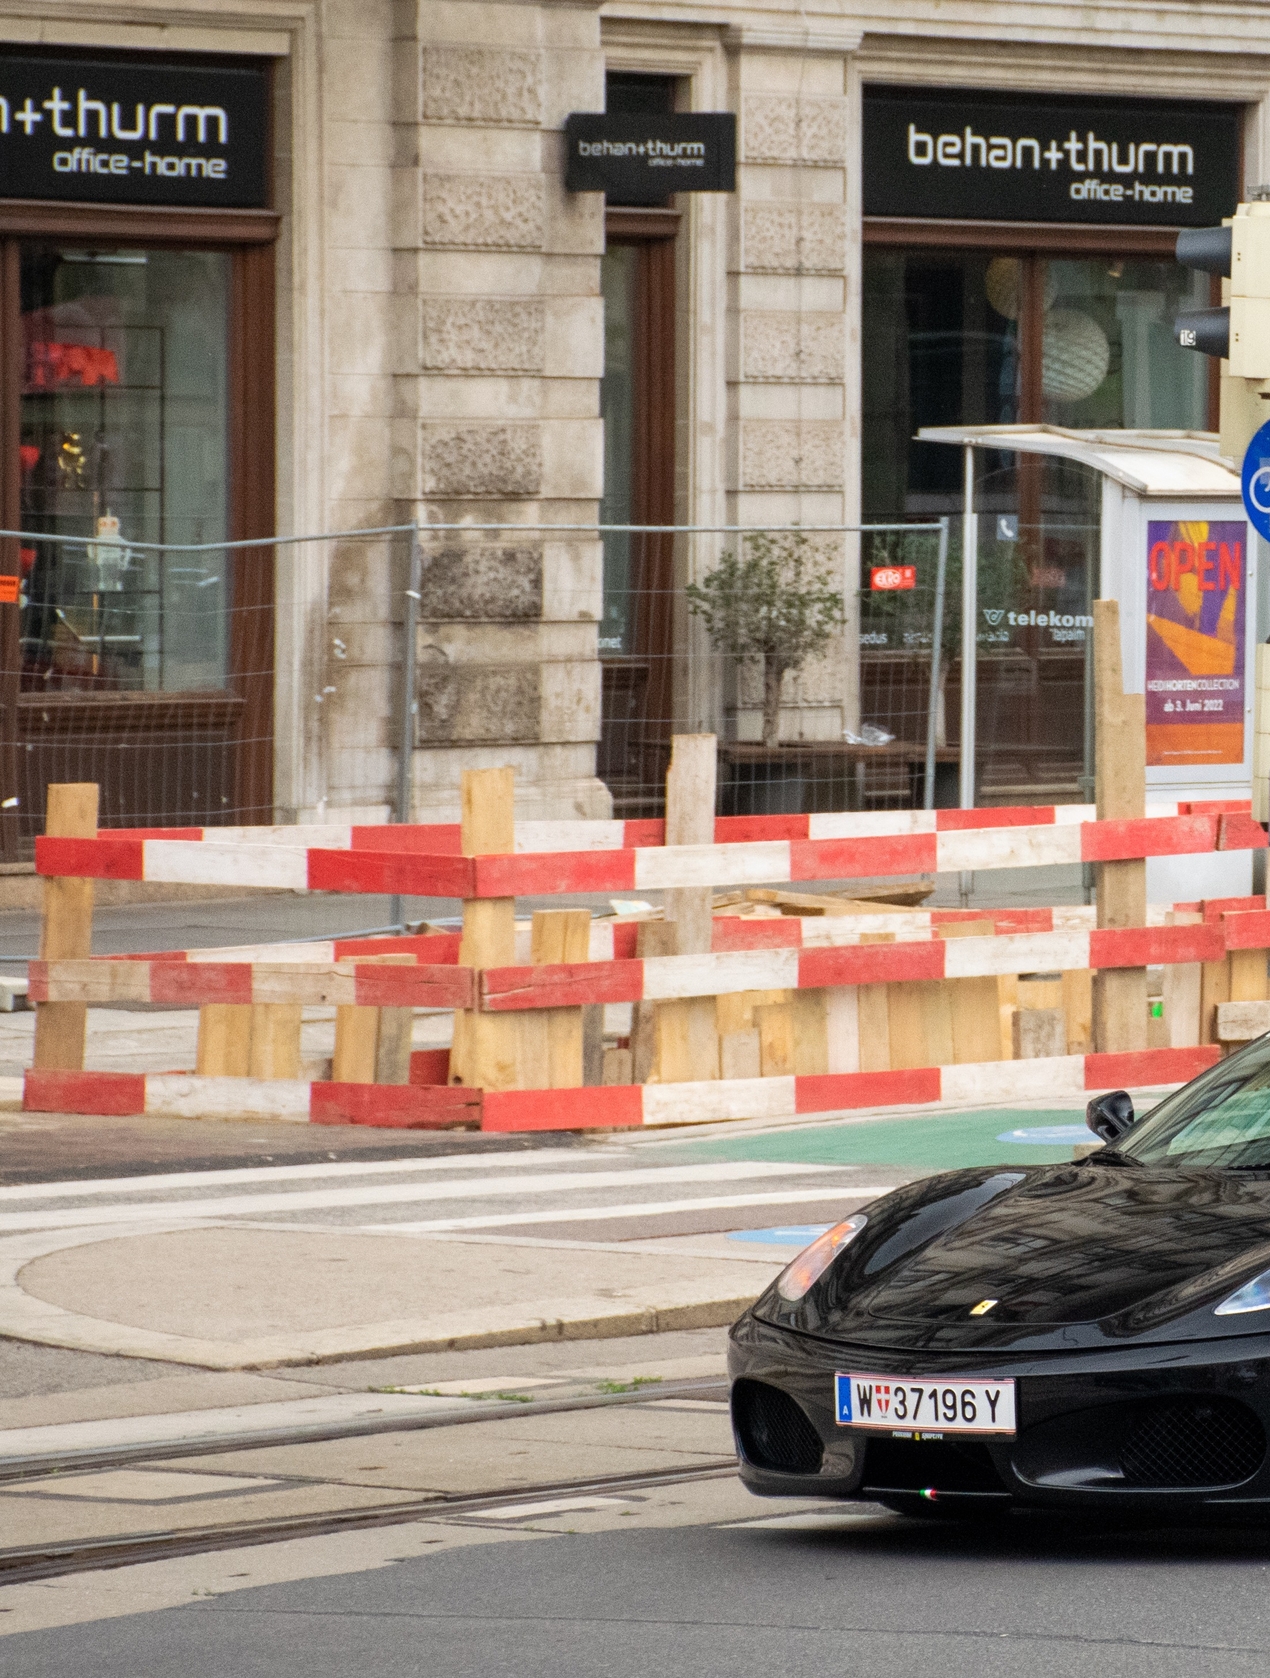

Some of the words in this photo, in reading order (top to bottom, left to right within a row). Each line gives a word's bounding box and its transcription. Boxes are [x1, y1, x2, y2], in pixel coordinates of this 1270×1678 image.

[0, 85, 229, 145] +thurm
[52, 147, 229, 179] office-home
[577, 139, 706, 157] behan+thurm
[907, 122, 1194, 175] behan+thurm
[1070, 178, 1194, 204] office-home
[1149, 540, 1242, 592] OPEN
[1008, 610, 1094, 628] telekom
[842, 1405, 849, 1416] A
[856, 1383, 873, 1418] W
[893, 1385, 977, 1423] 37196
[984, 1389, 1001, 1424] Y
